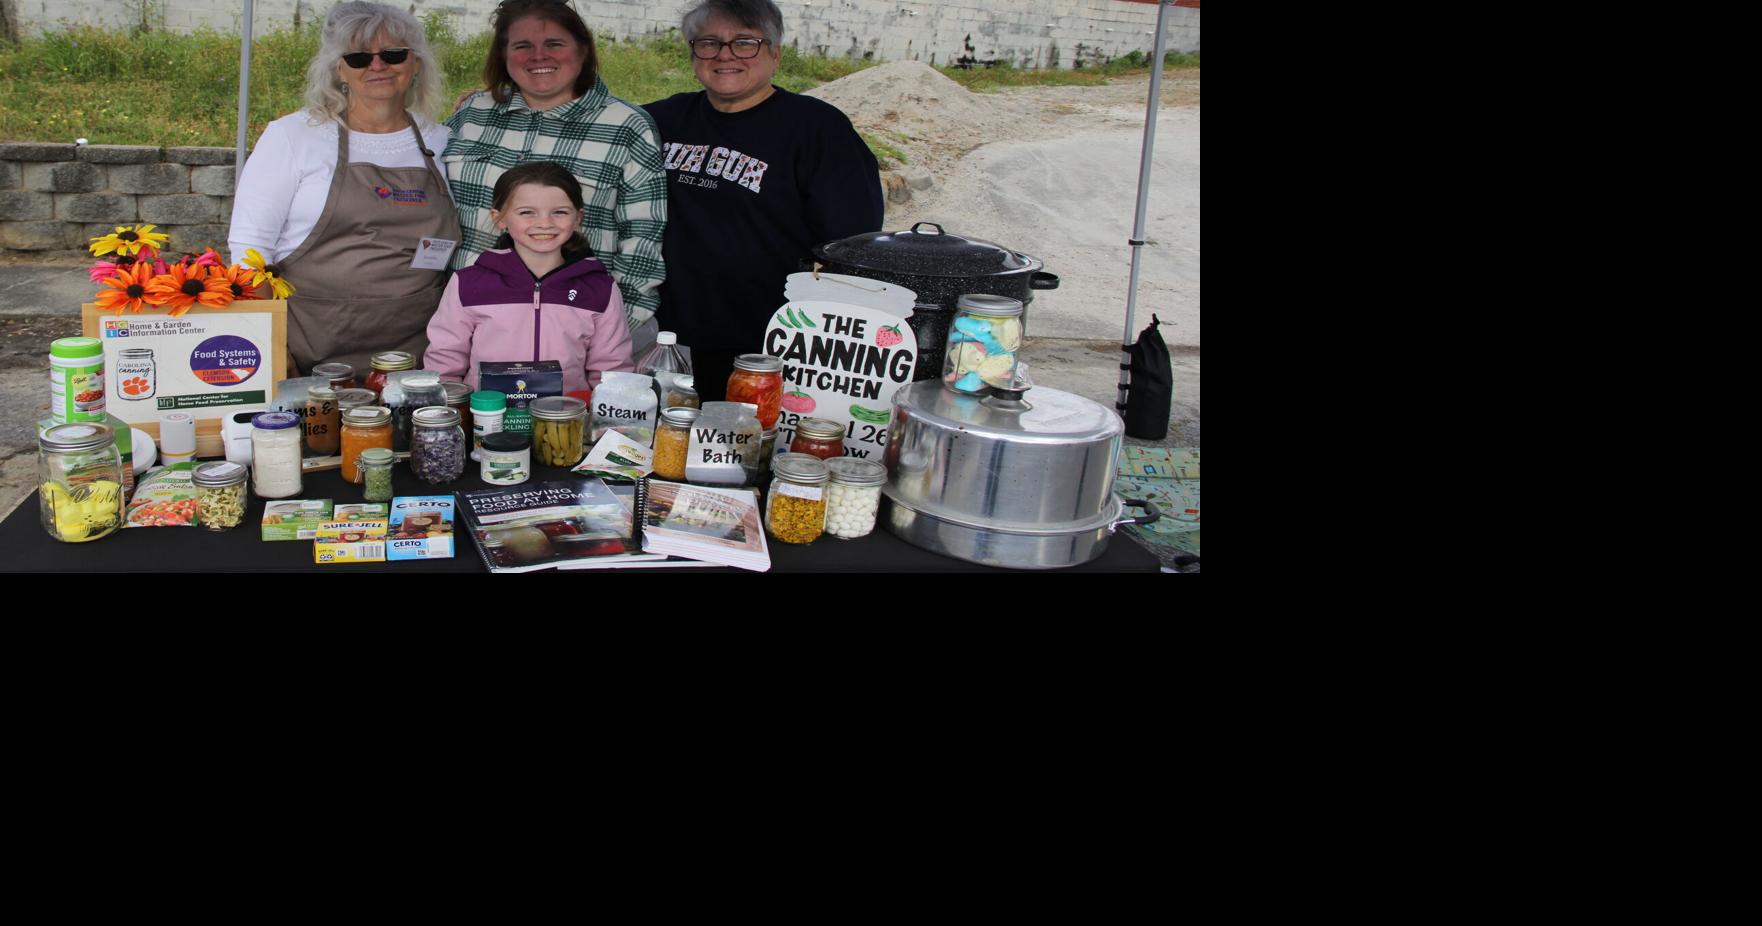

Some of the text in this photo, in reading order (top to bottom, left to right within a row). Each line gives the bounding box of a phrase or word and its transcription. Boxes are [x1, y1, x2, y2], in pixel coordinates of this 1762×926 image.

[705, 146, 768, 193] GUH
[678, 174, 718, 189] EST. 2016
[130, 327, 206, 336] Information Center
[163, 321, 192, 329] Garden
[822, 313, 867, 339] THE
[194, 349, 256, 359] Food Systems
[766, 327, 914, 383] CANNING
[228, 357, 256, 367] Safety
[118, 367, 151, 377] canning
[782, 364, 882, 400] KITCHEN
[322, 401, 335, 415] &
[597, 403, 647, 421] Steam
[696, 428, 753, 446] Water
[702, 448, 742, 464] Bath
[468, 487, 572, 505] PRESERVING
[472, 492, 594, 510] FOOD AT HOME
[396, 501, 451, 509] CERTO
[474, 503, 527, 514] RESOURCE
[393, 540, 422, 548] CERTO
